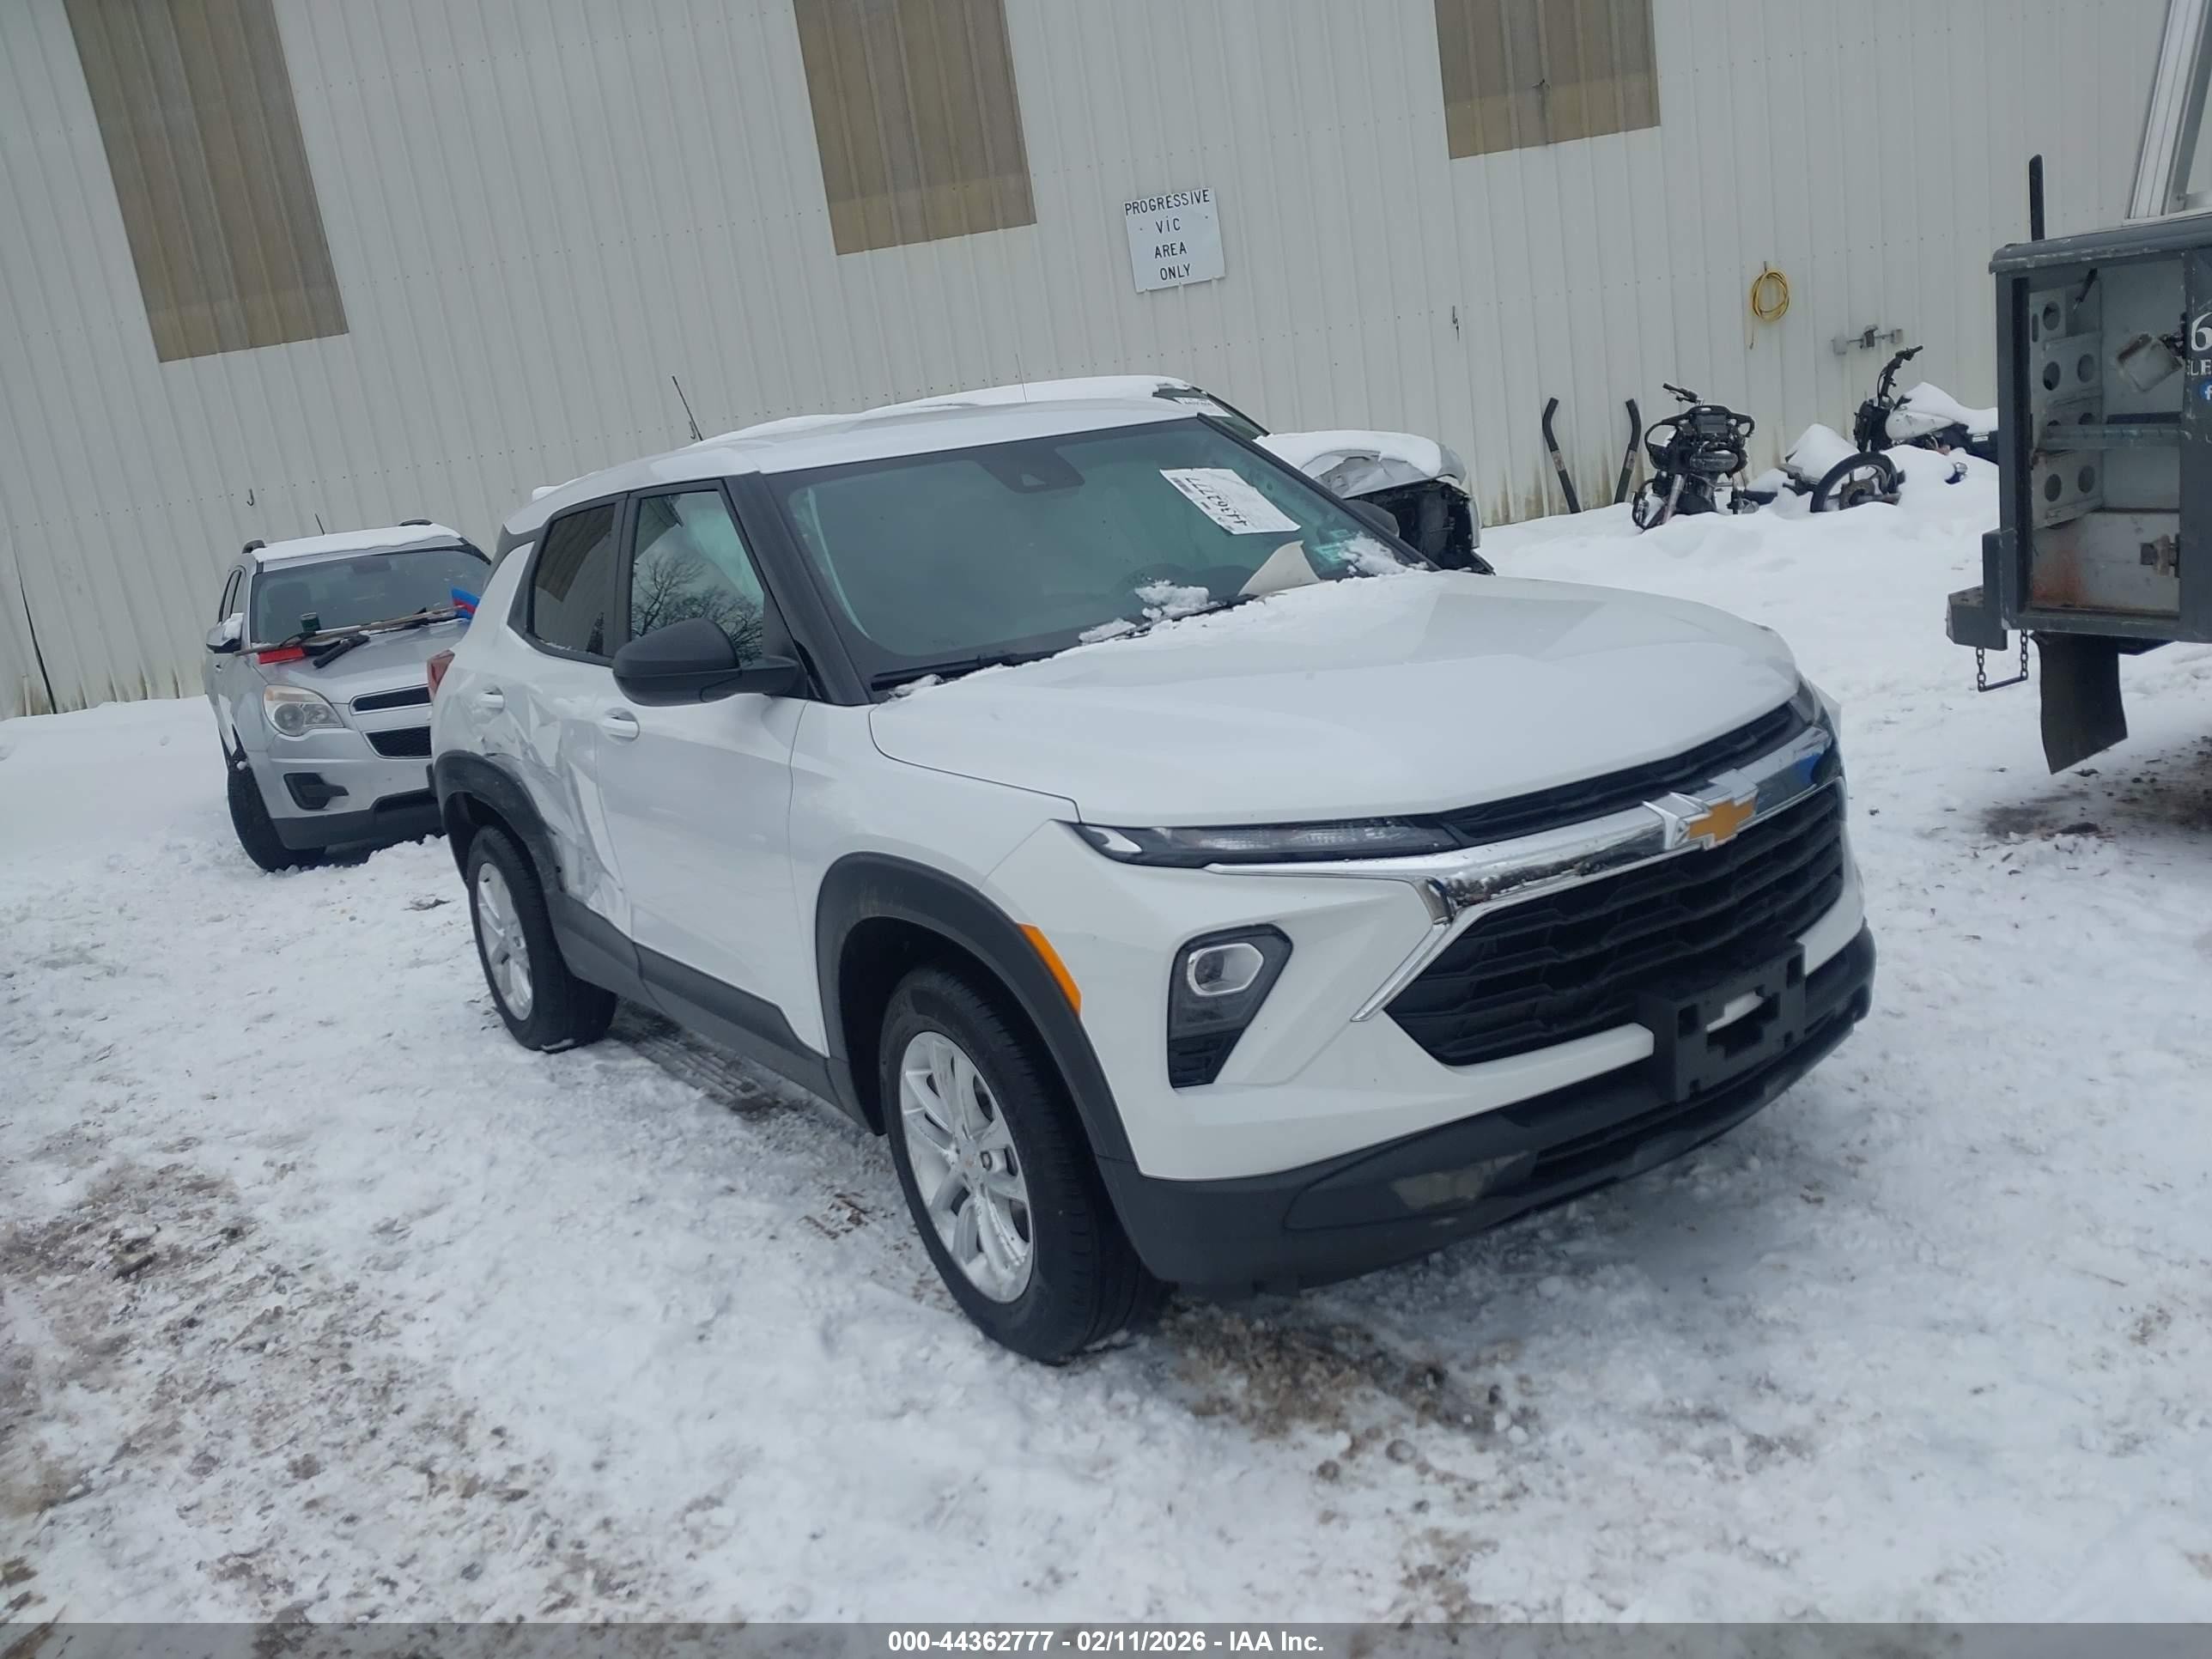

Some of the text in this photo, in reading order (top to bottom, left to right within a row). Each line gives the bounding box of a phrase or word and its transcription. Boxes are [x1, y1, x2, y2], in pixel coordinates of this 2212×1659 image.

[1124, 189, 1210, 216] PROGRESSIVE
[1154, 241, 1188, 259] AREA
[1160, 263, 1191, 281] ONLY
[1185, 477, 1249, 526] 44362777
